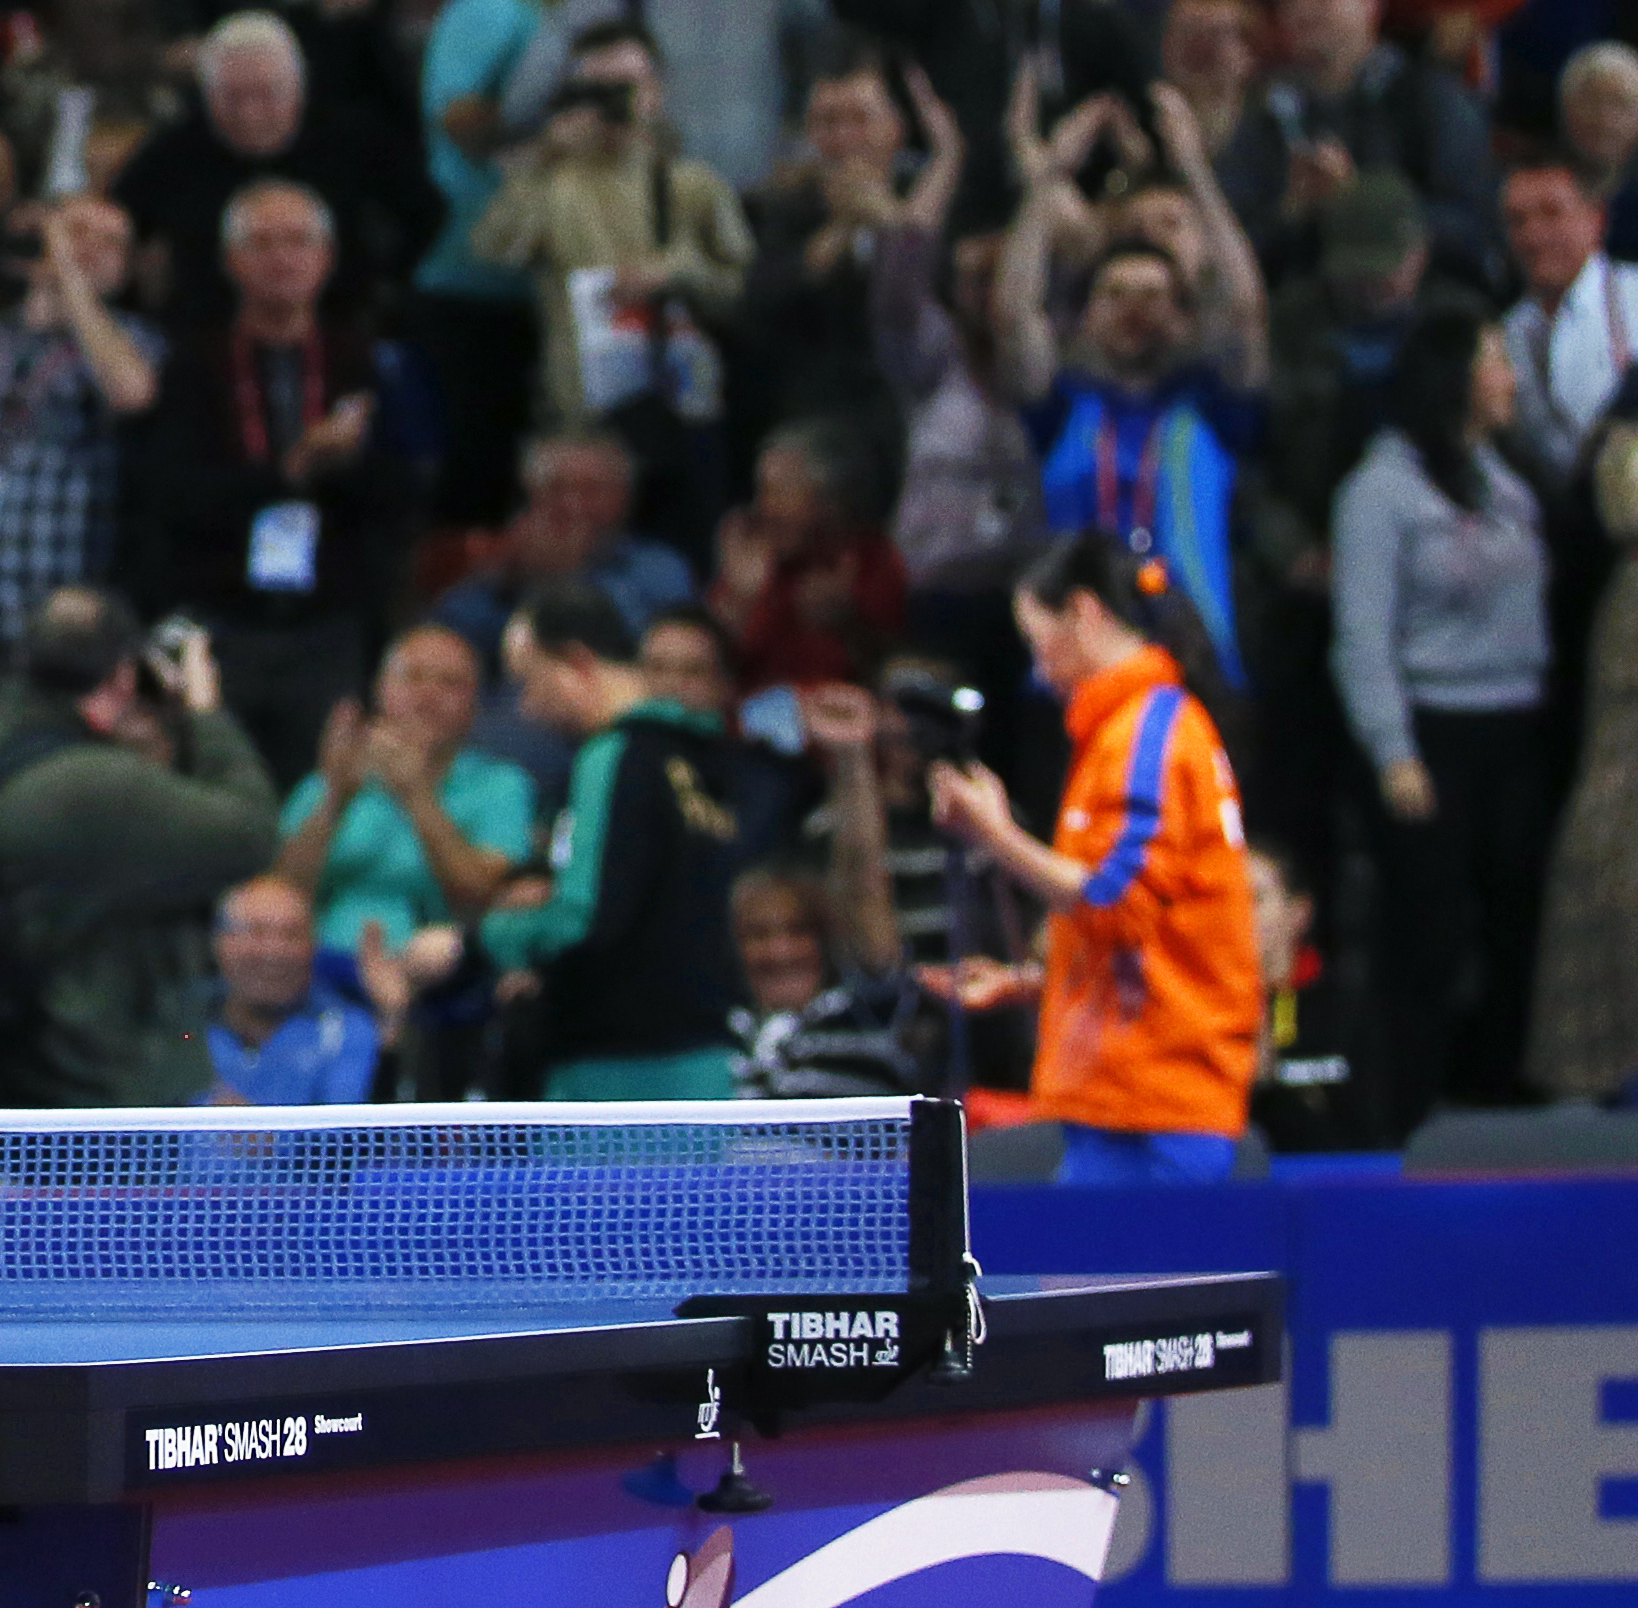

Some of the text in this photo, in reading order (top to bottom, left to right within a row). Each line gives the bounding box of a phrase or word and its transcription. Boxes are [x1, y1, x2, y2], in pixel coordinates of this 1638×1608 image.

[766, 1310, 901, 1340] TIBHAR
[767, 1342, 870, 1368] SMASH
[224, 1419, 281, 1463] SMASH
[282, 1415, 308, 1457] 28
